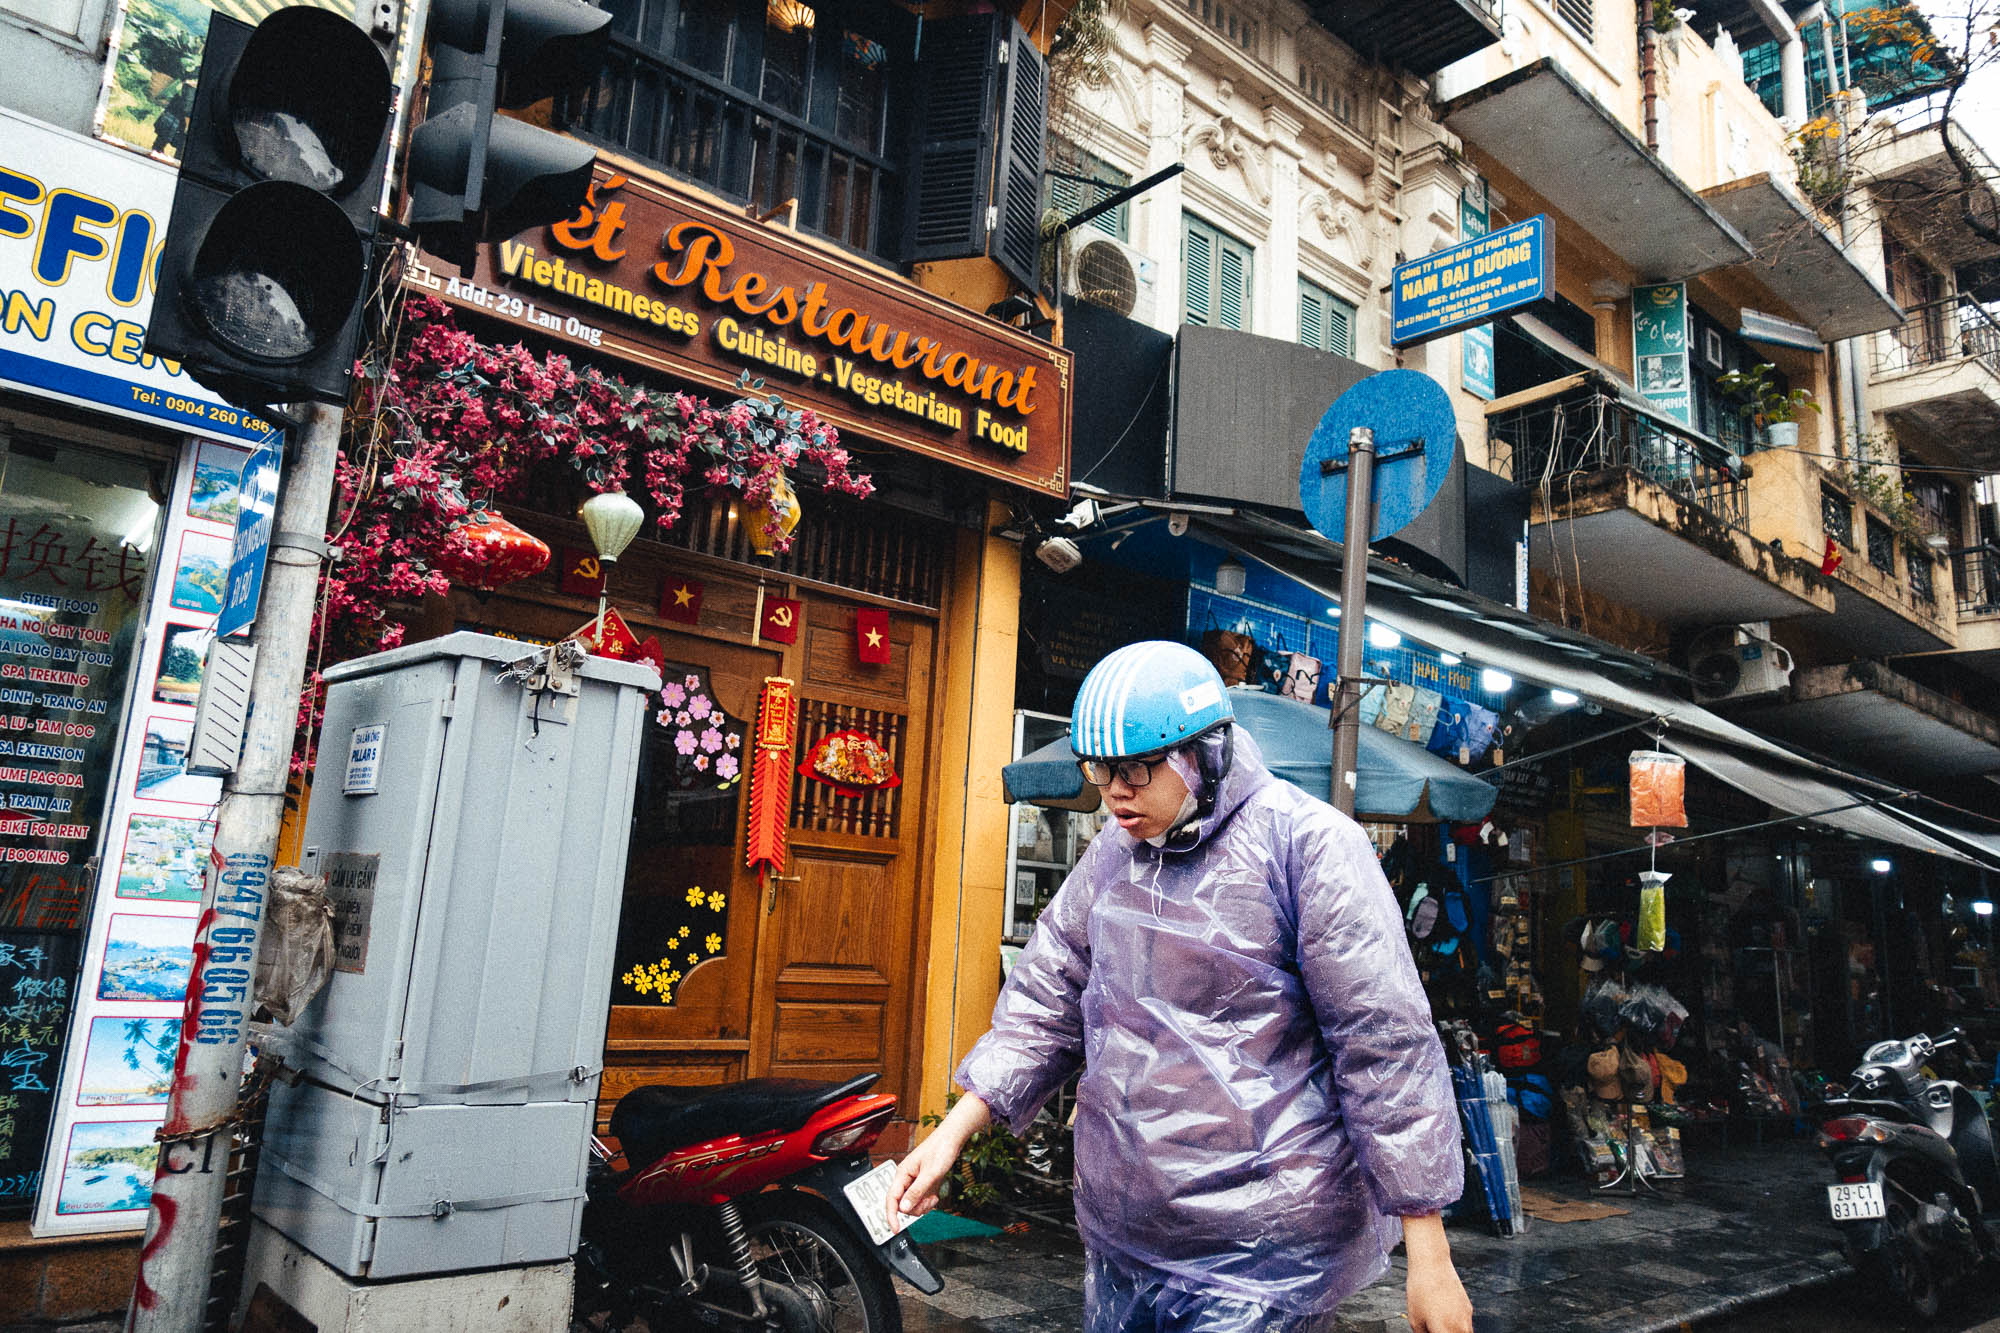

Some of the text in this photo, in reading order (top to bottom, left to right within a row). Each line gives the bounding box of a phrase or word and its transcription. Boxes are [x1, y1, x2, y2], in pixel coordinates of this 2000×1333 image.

[1402, 242, 1531, 302] NAM ĐẠI DƯƠNG
[447, 277, 603, 347] Add: 29 Lan Ong
[655, 220, 1038, 416] Restaurant
[501, 240, 700, 338] Vietnameses
[717, 317, 818, 378] Cuisine
[833, 356, 962, 431] Vegetarian
[977, 407, 1028, 453] Food
[131, 386, 160, 406] Tel:
[166, 396, 205, 417] 0904
[208, 406, 238, 425] 260
[21, 592, 99, 614] STREET FOOD
[22, 621, 46, 635] NOI
[48, 623, 76, 640] CITY
[78, 629, 111, 644] TOUR
[15, 642, 51, 658] LONG
[53, 648, 78, 662] BAY
[80, 652, 113, 667] TOUR
[1, 665, 90, 688] SPA TREKKING
[1, 689, 33, 705] DINH
[42, 694, 85, 712] TRANG
[87, 701, 107, 715] AN
[11, 716, 27, 730] LU
[36, 719, 62, 734] TAM
[64, 722, 96, 738] COC
[16, 743, 86, 762] EXTENSION
[29, 769, 85, 789] PAGODA
[10, 793, 48, 811] TRAIN
[49, 797, 73, 813] AIR
[0, 820, 91, 840] BIKE FOR RENT
[7, 848, 70, 865] BOOKING
[1835, 1184, 1872, 1201] 29-C1
[1834, 1200, 1880, 1218] 831.11
